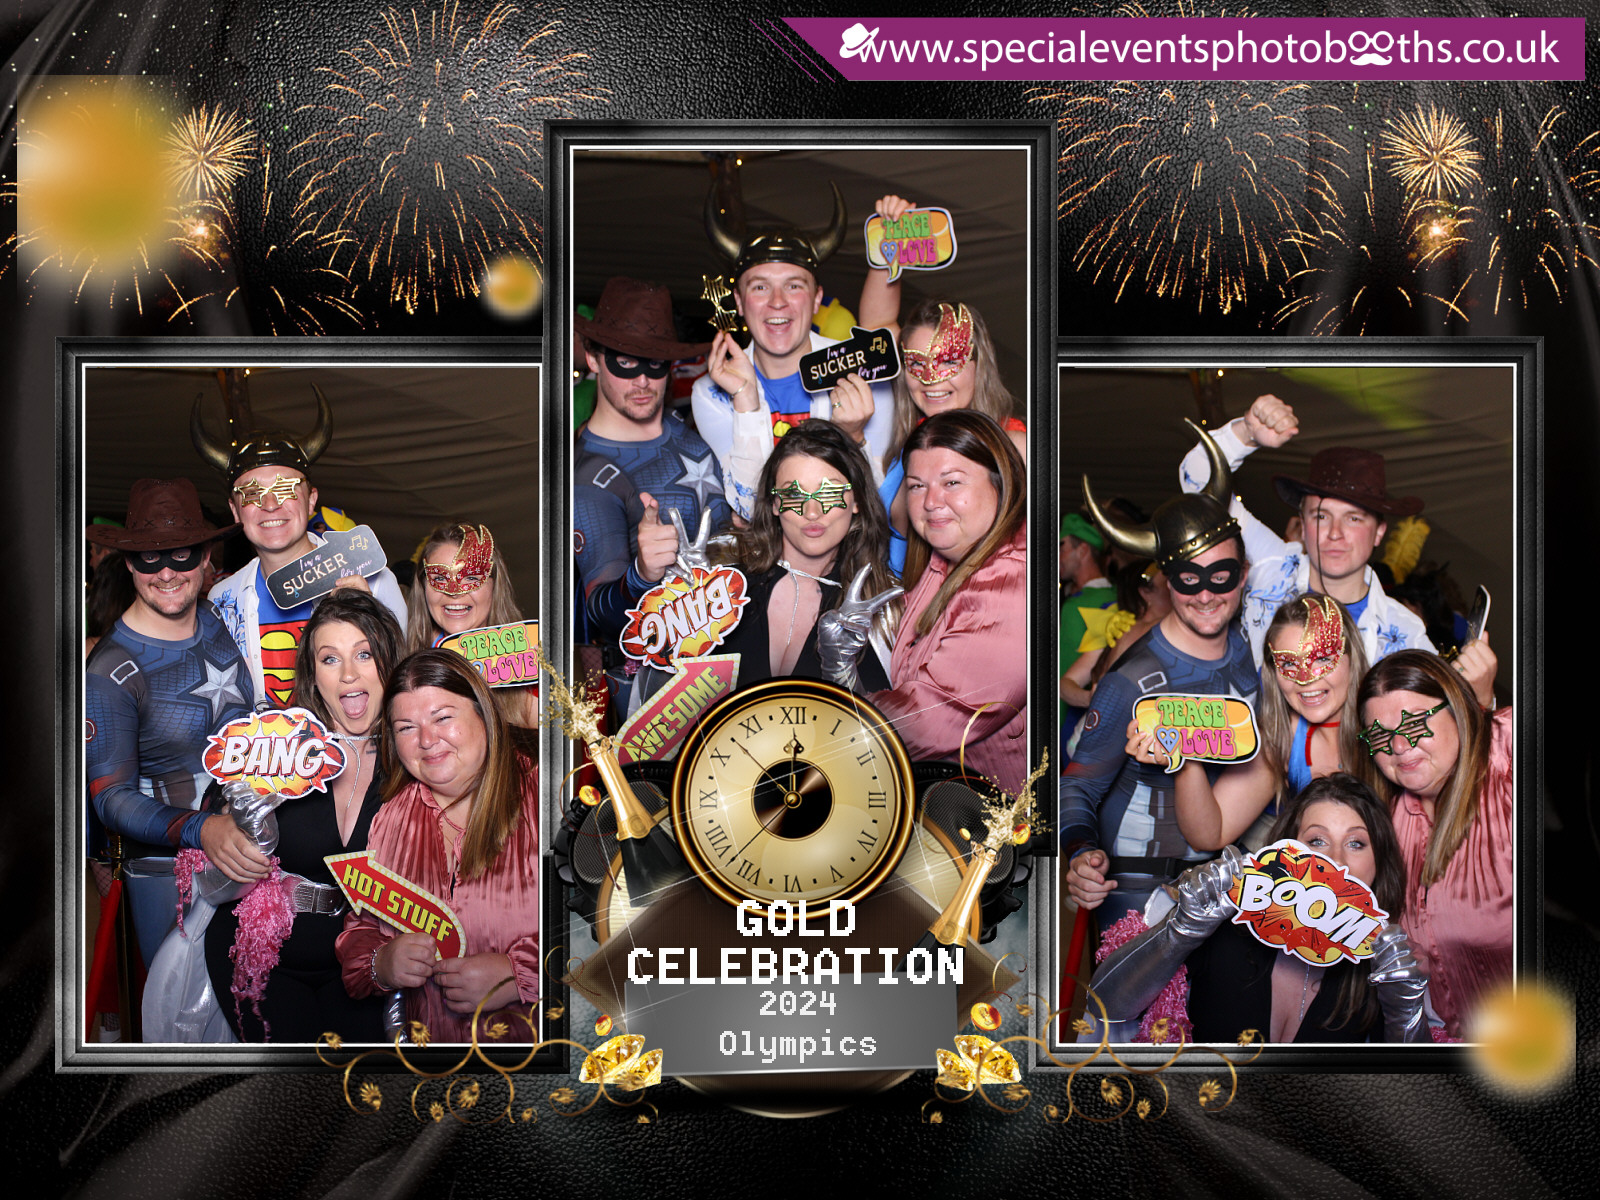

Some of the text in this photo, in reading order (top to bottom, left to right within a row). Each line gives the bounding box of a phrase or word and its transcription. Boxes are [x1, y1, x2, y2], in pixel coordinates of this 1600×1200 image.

[883, 212, 931, 240] PEACE
[898, 238, 937, 264] LOVE
[810, 350, 867, 380] SUCKER
[283, 552, 348, 595] SUCKER
[356, 560, 373, 575] you
[641, 575, 734, 655] BANG
[461, 626, 528, 660] PEACE
[484, 651, 538, 683] LOVE
[626, 666, 728, 762] AWESOME
[1158, 700, 1226, 728] PEACE
[220, 735, 327, 779] BANG
[1180, 728, 1234, 756] LOVE
[343, 864, 453, 942] HOT STUFF
[1239, 874, 1381, 950] BOOM
